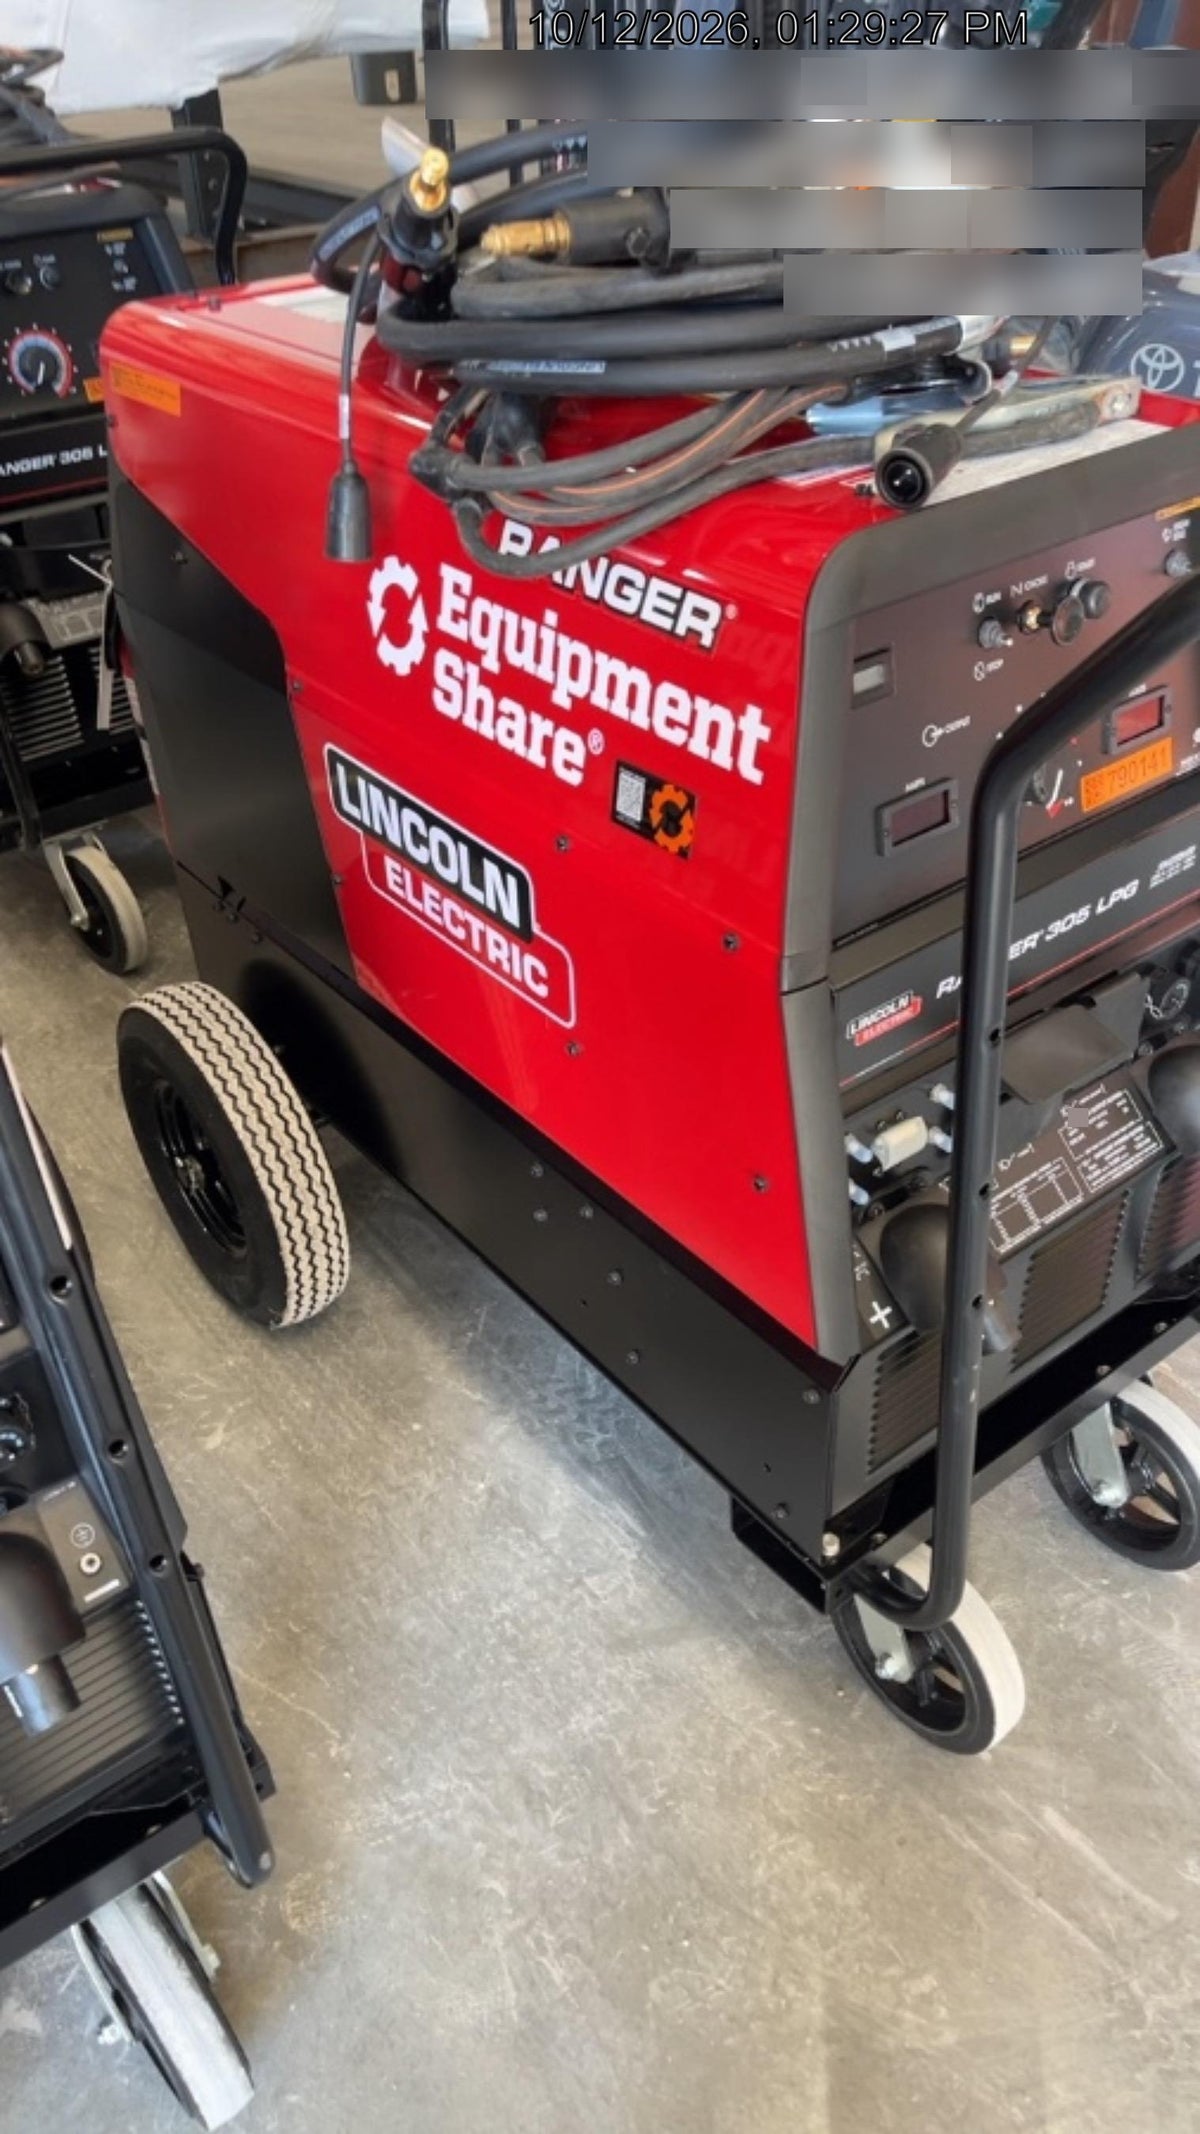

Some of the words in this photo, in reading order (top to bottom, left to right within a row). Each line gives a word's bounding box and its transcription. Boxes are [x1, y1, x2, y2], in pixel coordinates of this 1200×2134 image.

[437, 562, 771, 785] Equipment
[336, 762, 520, 929] LINCOLN
[1107, 744, 1169, 794] 790141
[384, 855, 549, 999] ELECTRIC
